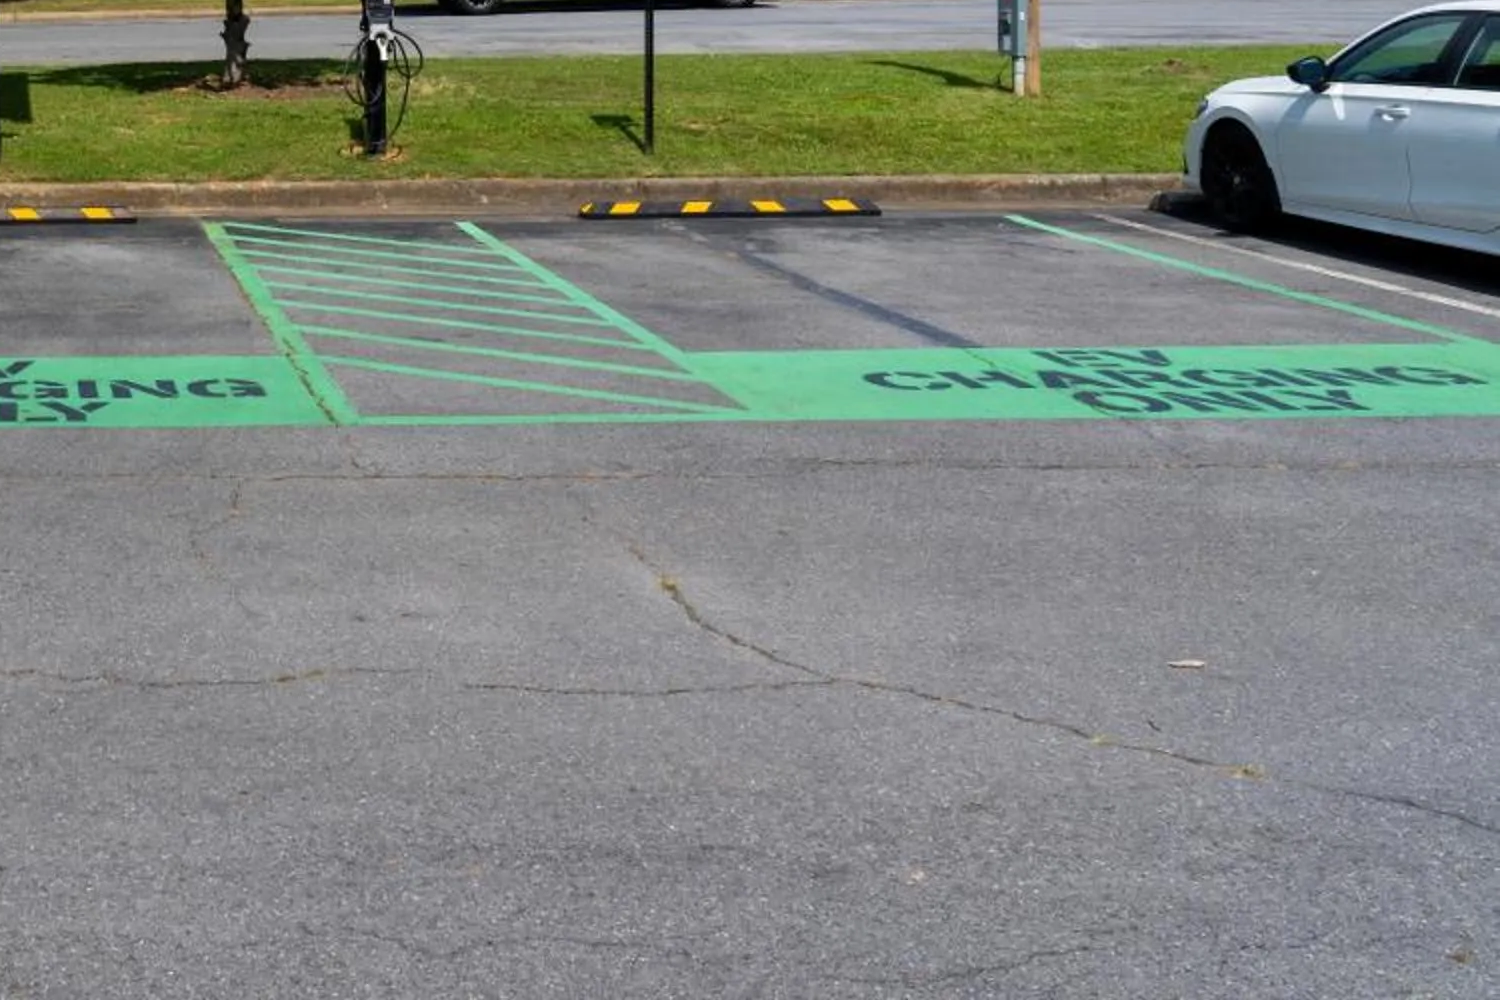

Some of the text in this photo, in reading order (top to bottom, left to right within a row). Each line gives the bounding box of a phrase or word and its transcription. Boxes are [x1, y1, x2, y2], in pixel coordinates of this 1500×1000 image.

[1030, 349, 1173, 368] EV
[862, 366, 1490, 390] CHARGING
[1072, 389, 1373, 413] ONLY
